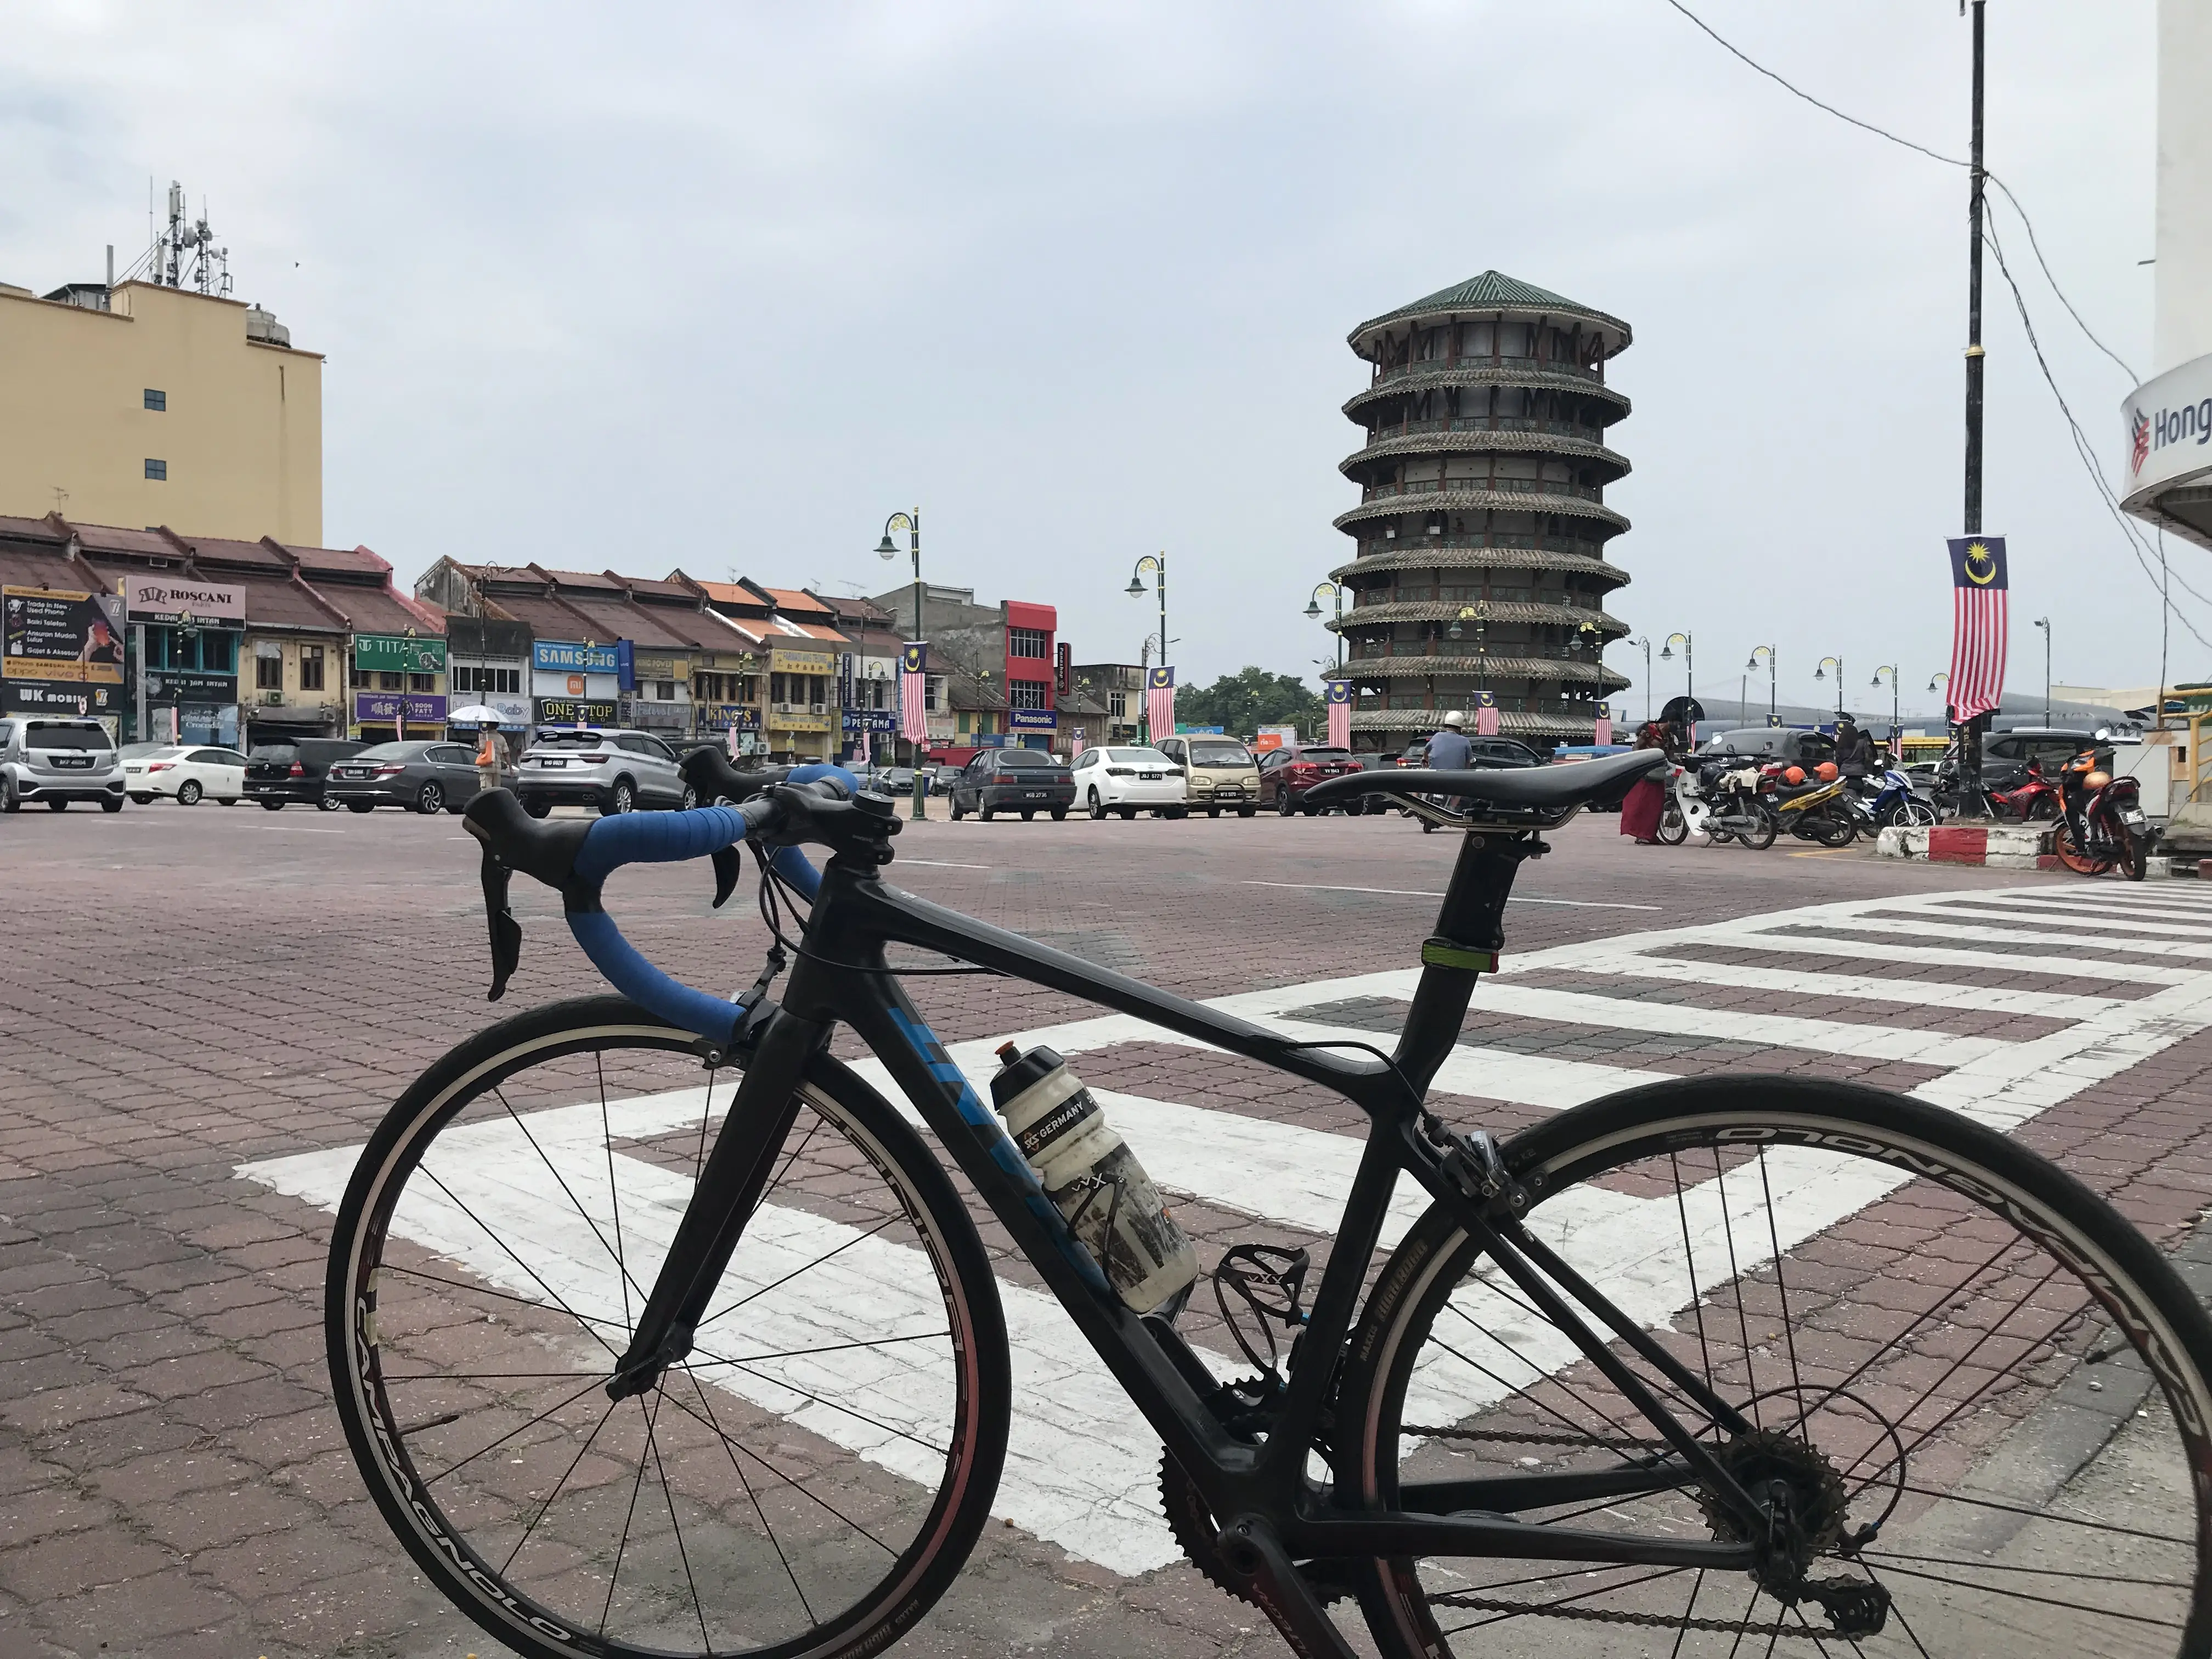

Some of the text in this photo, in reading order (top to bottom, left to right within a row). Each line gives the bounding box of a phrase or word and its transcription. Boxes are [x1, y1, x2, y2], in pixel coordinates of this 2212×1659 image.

[2154, 398, 2212, 451] Hong
[170, 589, 232, 603] ROSCANI
[154, 613, 178, 622] KEDAI
[20, 689, 44, 702] WK
[497, 703, 530, 718] Baby
[546, 703, 574, 715] ONE
[588, 705, 613, 717] TOP
[1015, 713, 1052, 724] Panasonic
[1024, 1101, 1084, 1149] SKS GERMANY
[1359, 1323, 1378, 1362] MAXXIS
[356, 1296, 572, 1641] CAMPAGNOLO
[894, 1598, 921, 1627] MAXXIS
